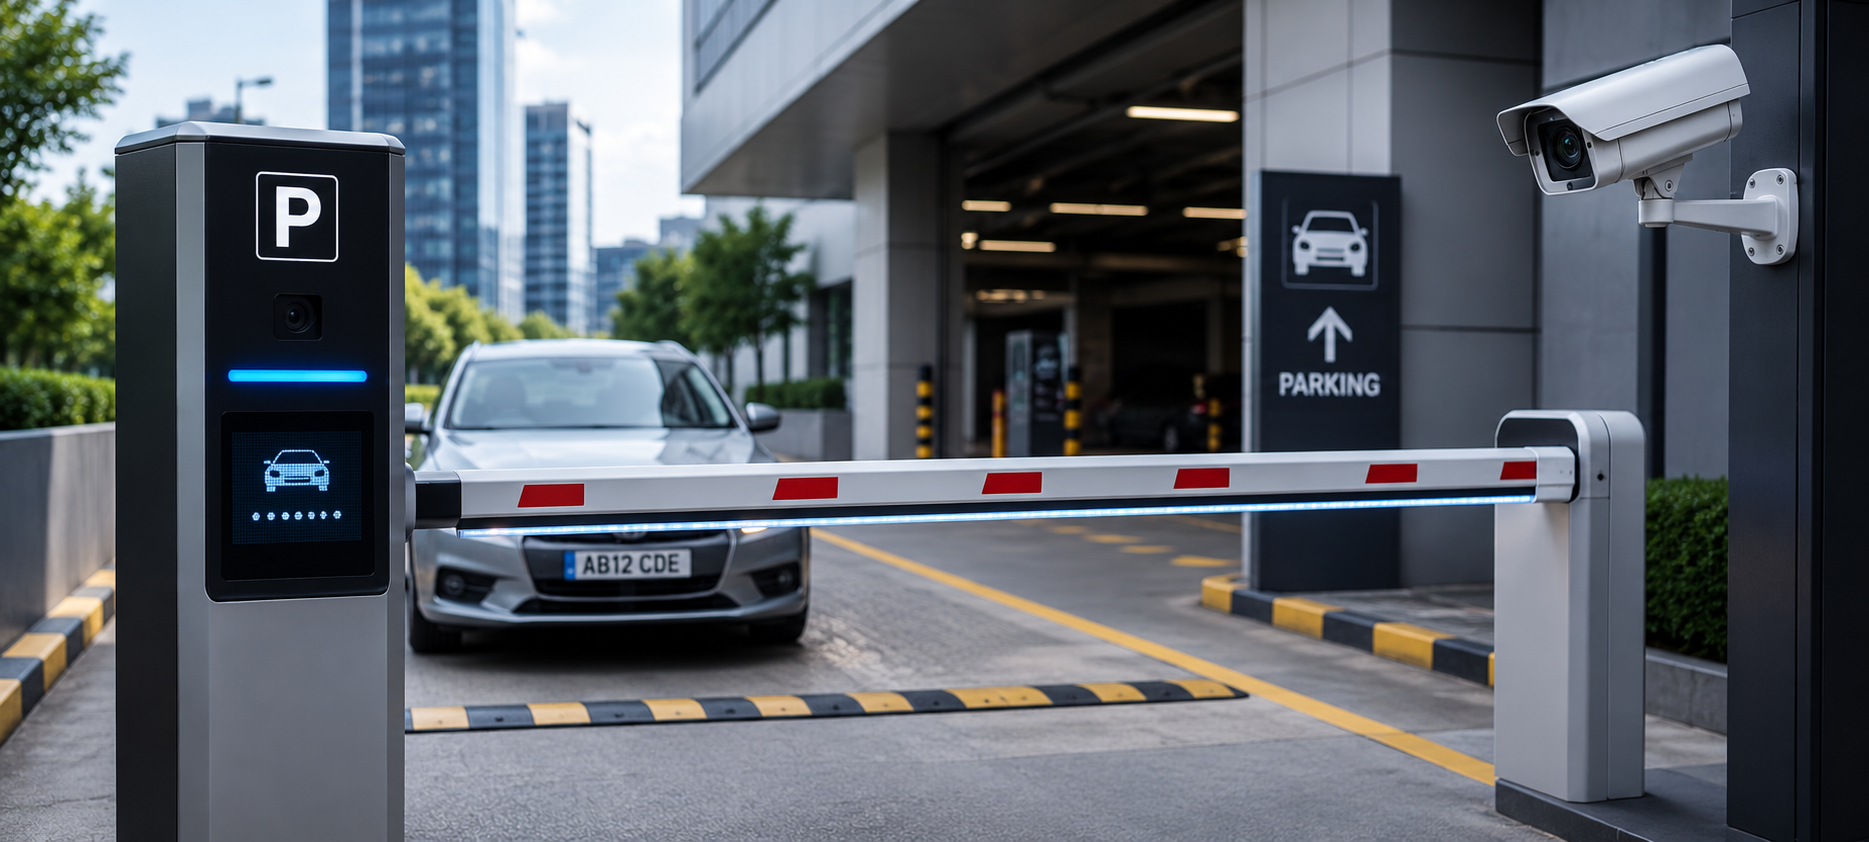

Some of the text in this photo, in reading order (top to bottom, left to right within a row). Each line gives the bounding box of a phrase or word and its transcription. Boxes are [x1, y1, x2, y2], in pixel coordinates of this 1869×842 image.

[276, 187, 321, 247] P
[1279, 373, 1381, 397] PARKING
[583, 553, 680, 575] AB12 CDE
